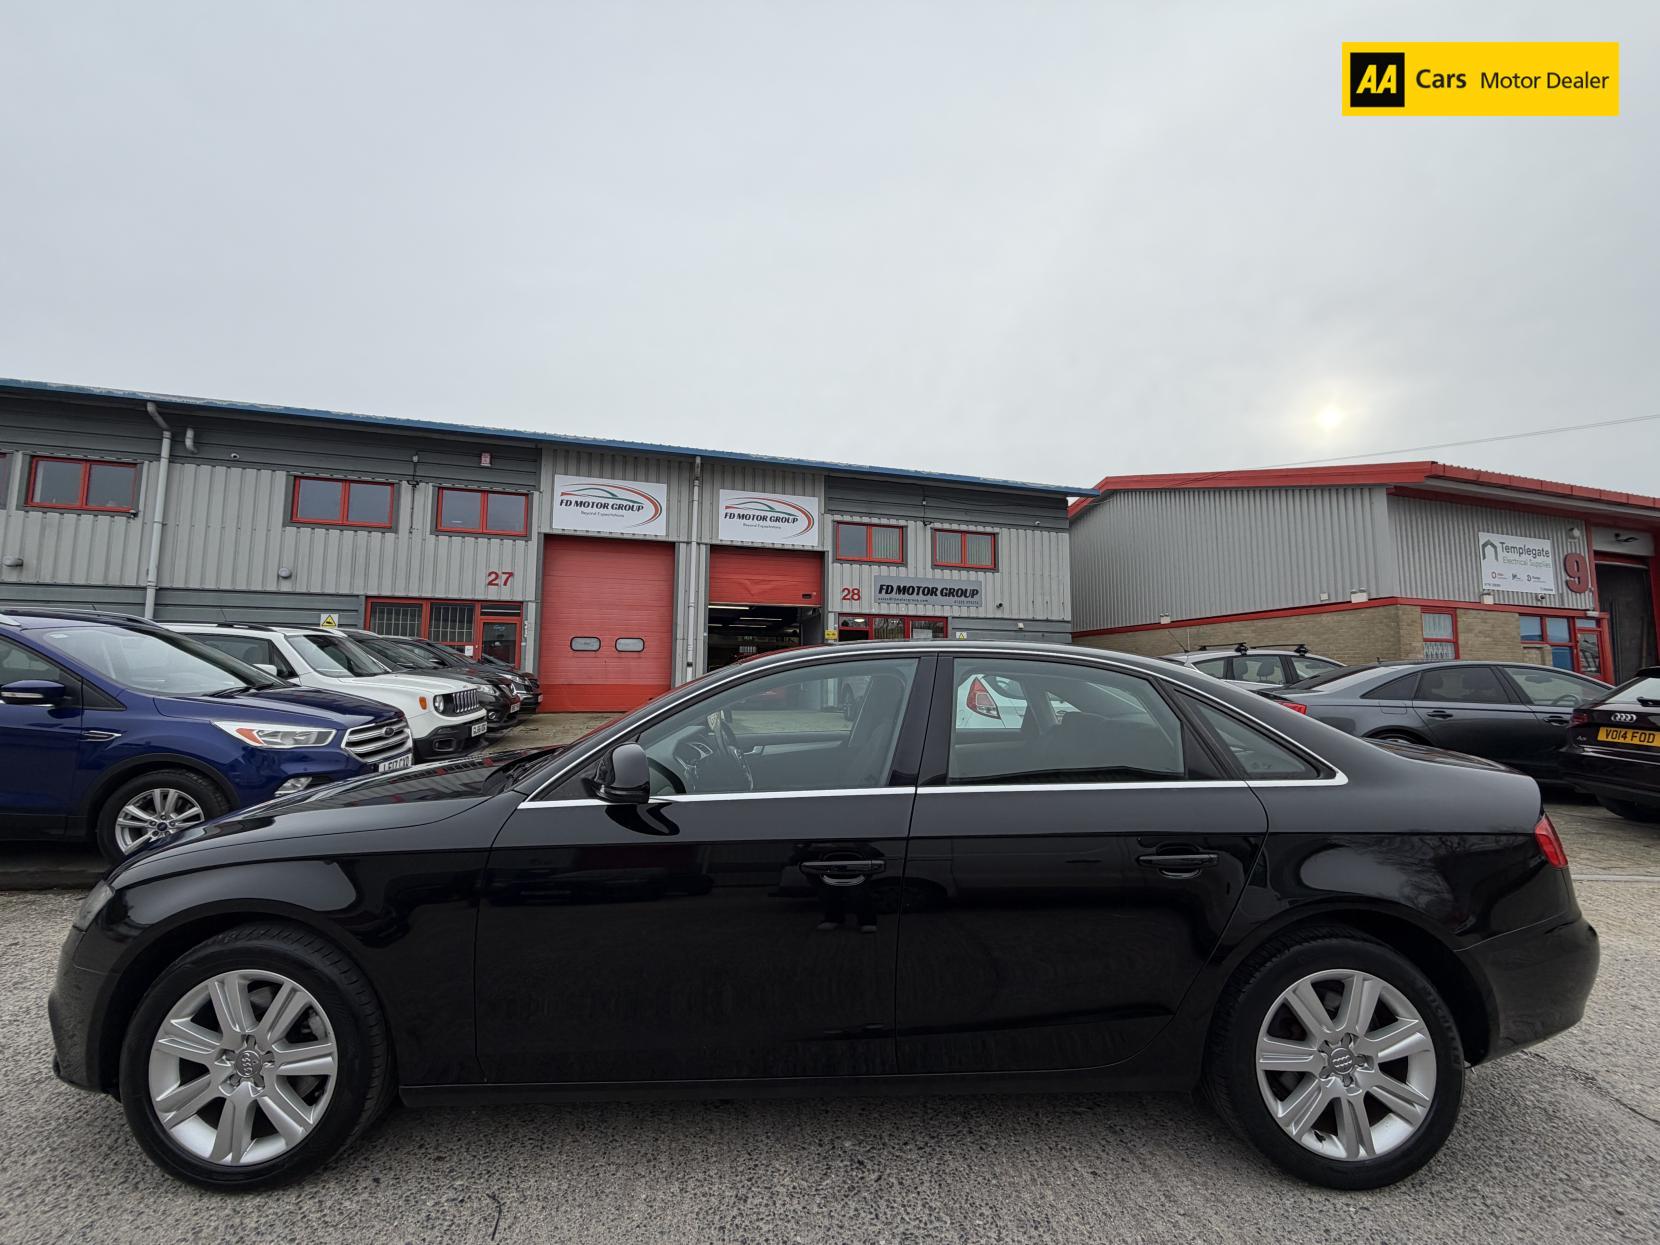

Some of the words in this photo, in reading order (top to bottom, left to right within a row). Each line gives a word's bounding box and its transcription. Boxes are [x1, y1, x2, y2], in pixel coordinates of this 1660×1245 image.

[560, 499, 573, 507] FD
[573, 500, 609, 510] MOTOR
[611, 503, 644, 512] GROUP
[724, 512, 735, 520] FD
[736, 513, 768, 522] MOTOR
[769, 515, 799, 524] GROUP
[1499, 541, 1550, 559] Templegate
[487, 571, 514, 587] 27
[1563, 552, 1590, 594] 9
[841, 587, 861, 601] 28
[878, 584, 894, 595] FD
[895, 585, 938, 597] MOTOR
[940, 587, 979, 599] GROUP
[1630, 731, 1656, 744] FOD
